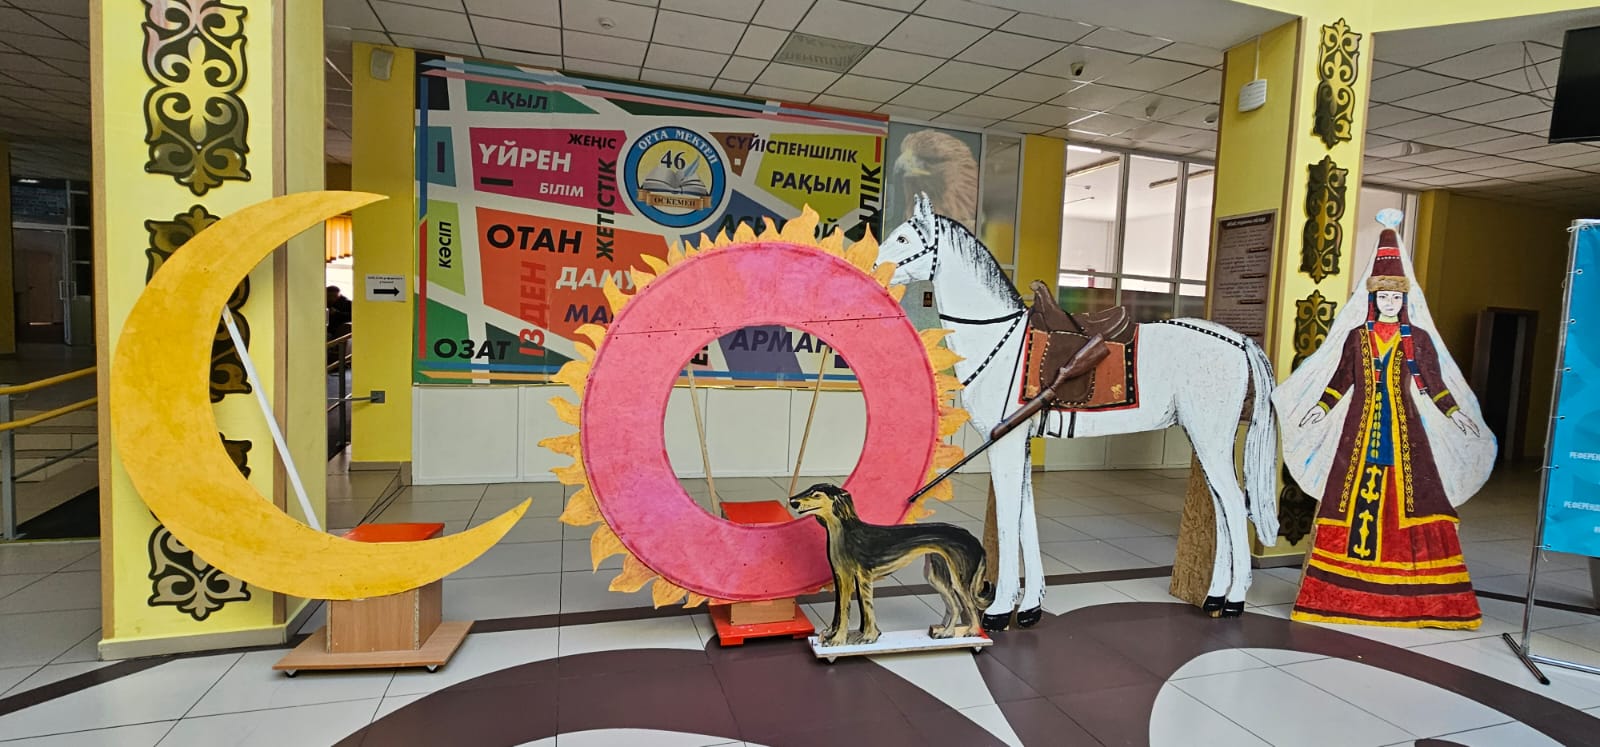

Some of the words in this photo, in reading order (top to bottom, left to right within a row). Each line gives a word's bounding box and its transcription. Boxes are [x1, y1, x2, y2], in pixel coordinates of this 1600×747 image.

[486, 90, 548, 110] АҚЫЛ
[478, 140, 572, 173] ҮЙРЕН
[567, 133, 617, 150] ЖЕҢІС
[638, 130, 669, 150] ОРТА
[675, 129, 718, 164] МЕКТЕП
[726, 132, 860, 164] СҮЙІСПЕНШІЛІК
[660, 149, 686, 170] 46
[539, 183, 584, 198] БІЛІМ
[770, 170, 851, 195] РАҚЫМ
[596, 157, 616, 262] ЖЕТІСТІК
[439, 221, 452, 269] КӘСІП
[486, 224, 582, 254] ОТАН
[519, 261, 547, 356] ІЗДЕН
[433, 338, 511, 360] ОЗАТ
